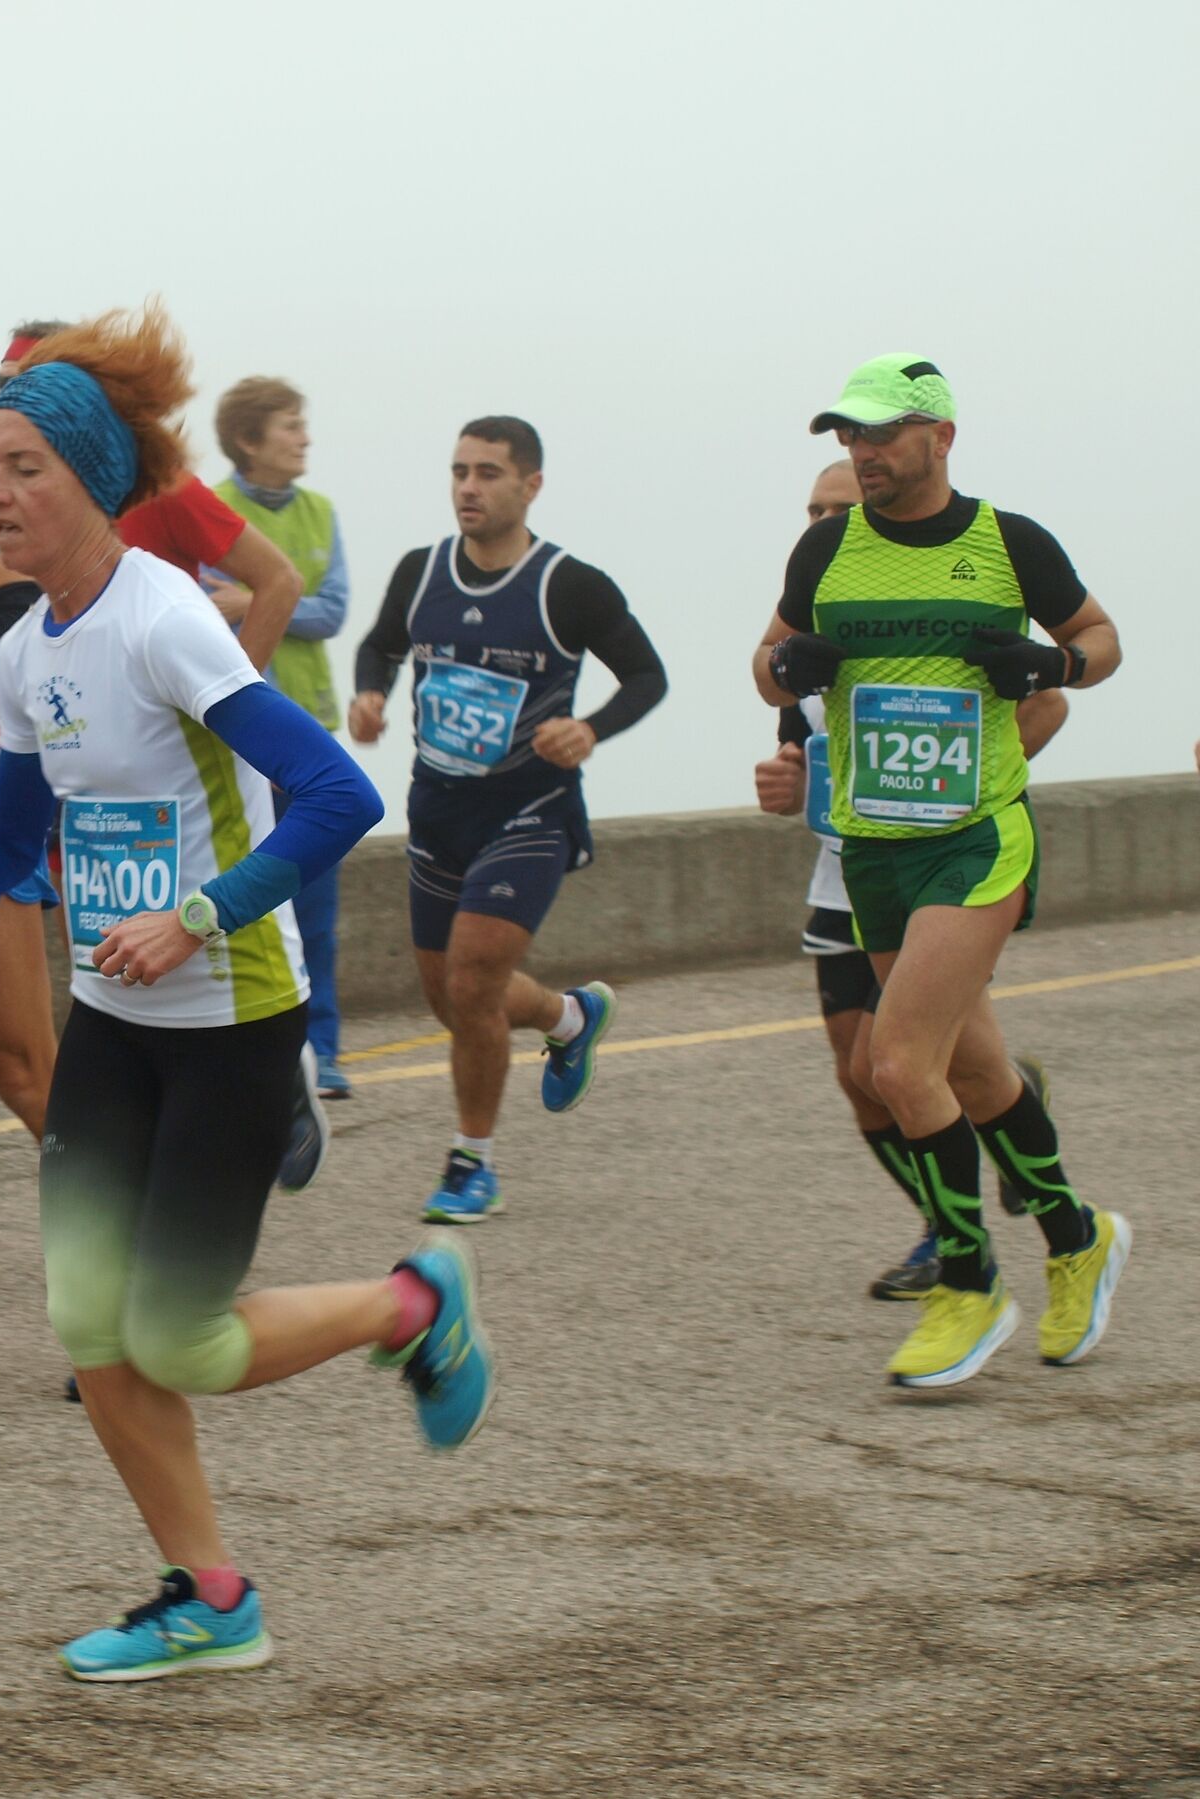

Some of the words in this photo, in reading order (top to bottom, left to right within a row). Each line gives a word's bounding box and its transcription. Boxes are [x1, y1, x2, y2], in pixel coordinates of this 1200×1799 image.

[836, 617, 997, 640] ORZIVECC
[424, 694, 506, 746] 1252
[862, 731, 973, 775] 1294
[880, 774, 925, 791] PAOLO
[68, 854, 171, 910] H4100
[78, 911, 129, 931] FEDERIC
